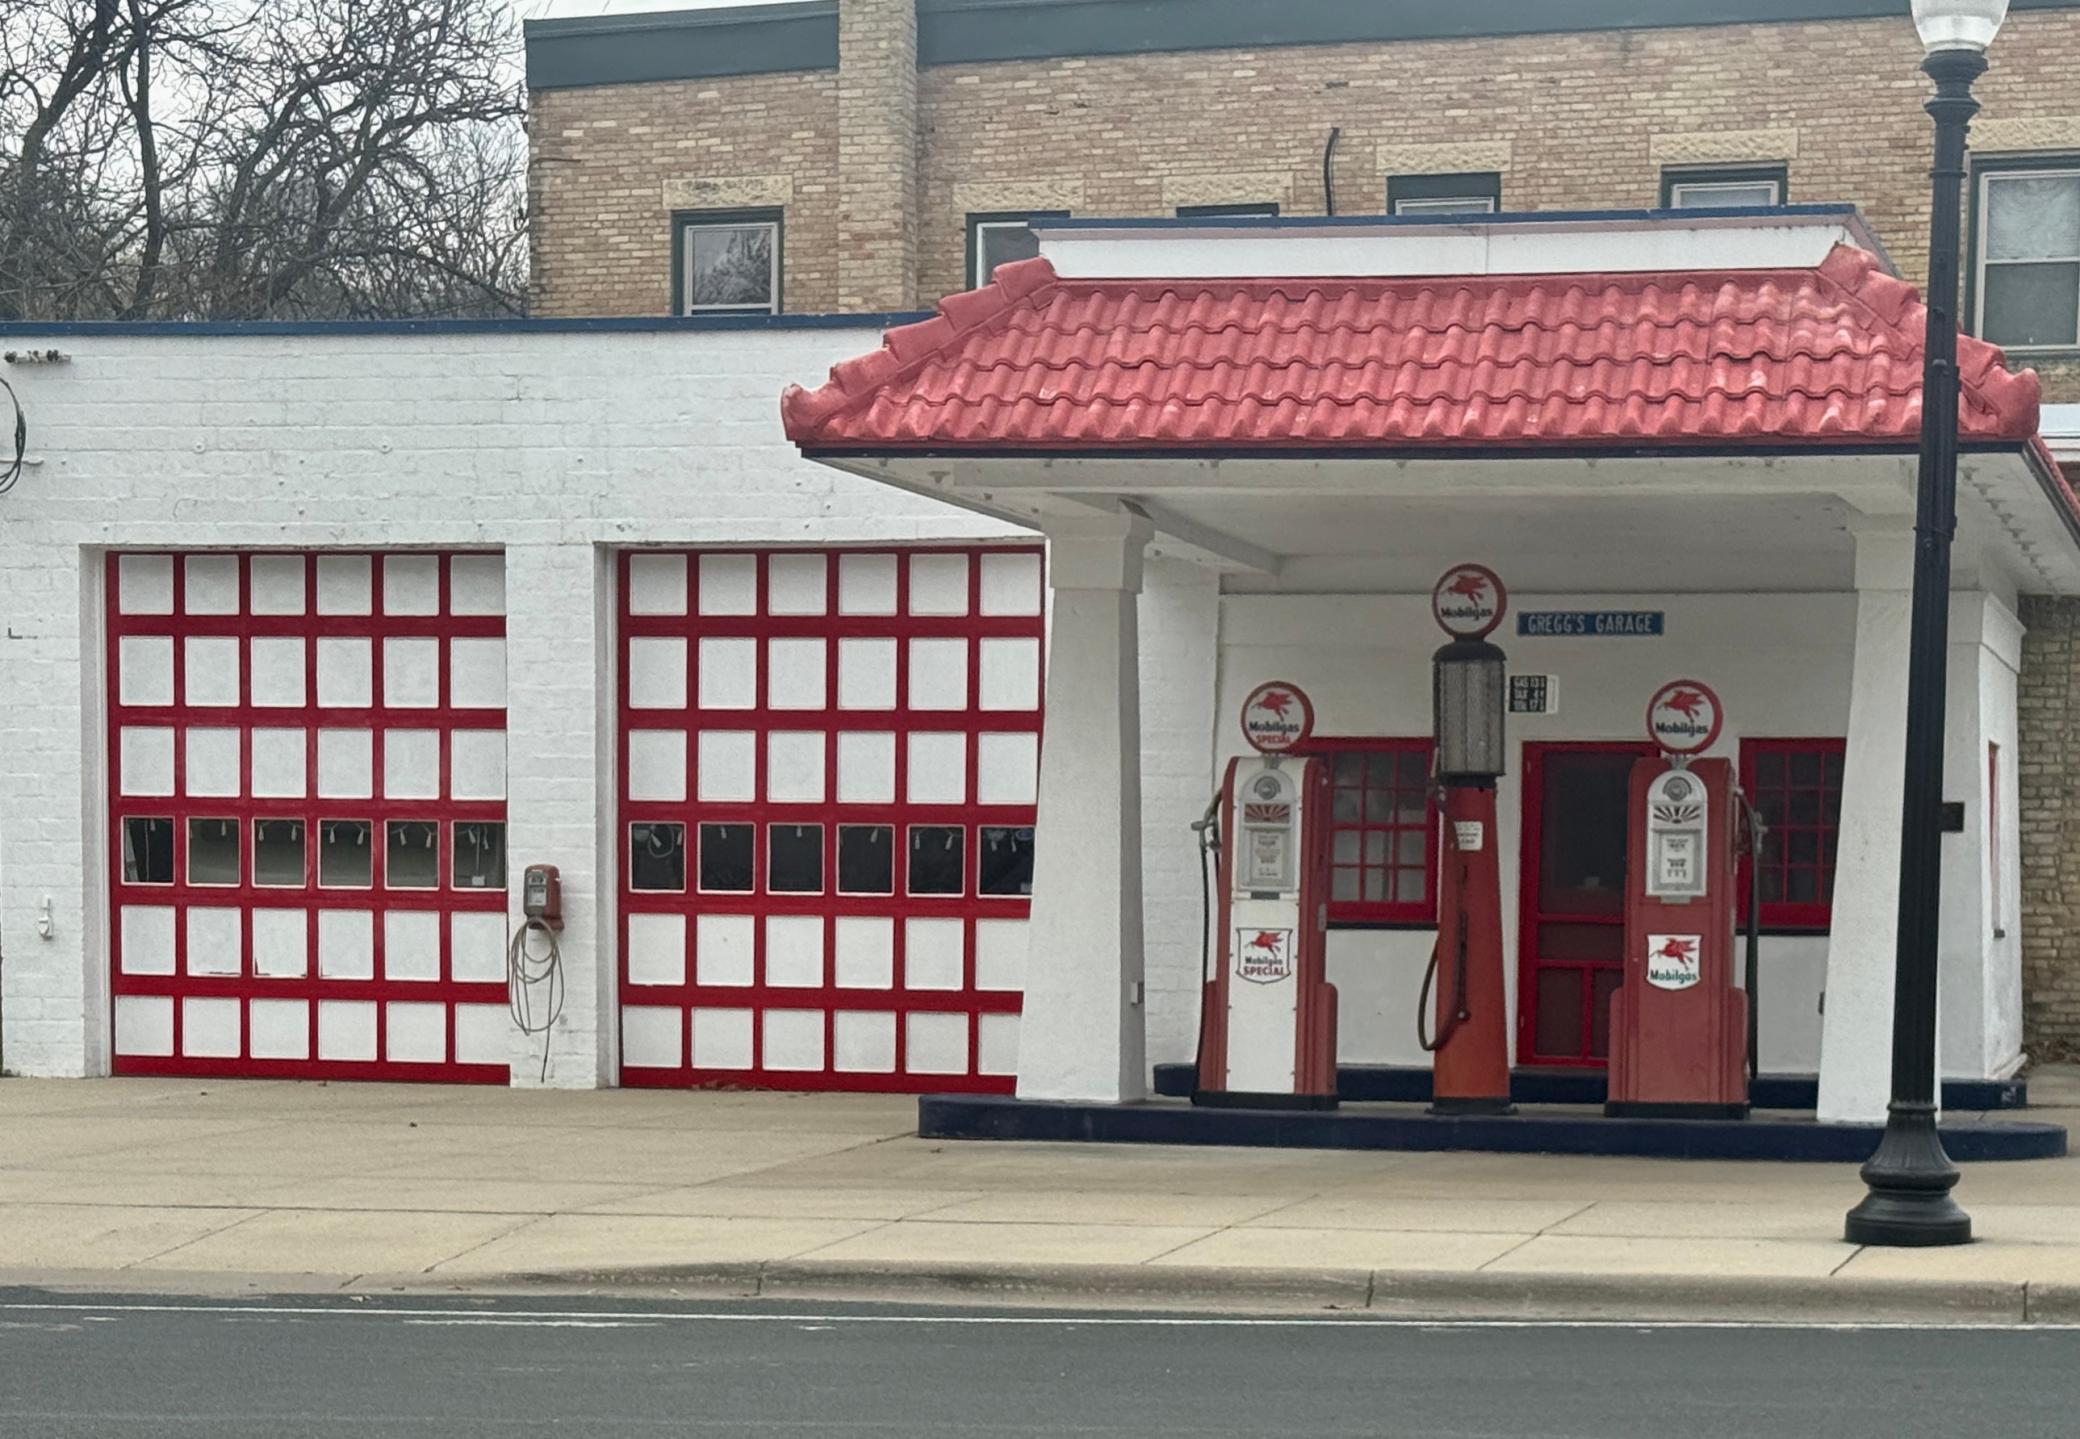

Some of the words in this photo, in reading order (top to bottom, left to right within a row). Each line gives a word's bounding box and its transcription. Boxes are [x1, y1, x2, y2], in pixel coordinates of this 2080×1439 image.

[1440, 606, 1493, 621] Mobilgas
[1527, 614, 1585, 633] GREGG'S
[1595, 614, 1653, 633] GARAGE
[1249, 720, 1300, 736] Mobilgas
[1655, 721, 1709, 738] Mobilgas
[1256, 735, 1291, 745] SPECIAL
[1245, 956, 1283, 967] Mobilgas
[1243, 966, 1285, 976] SPECIAL
[1650, 969, 1697, 984] Mobilgas
